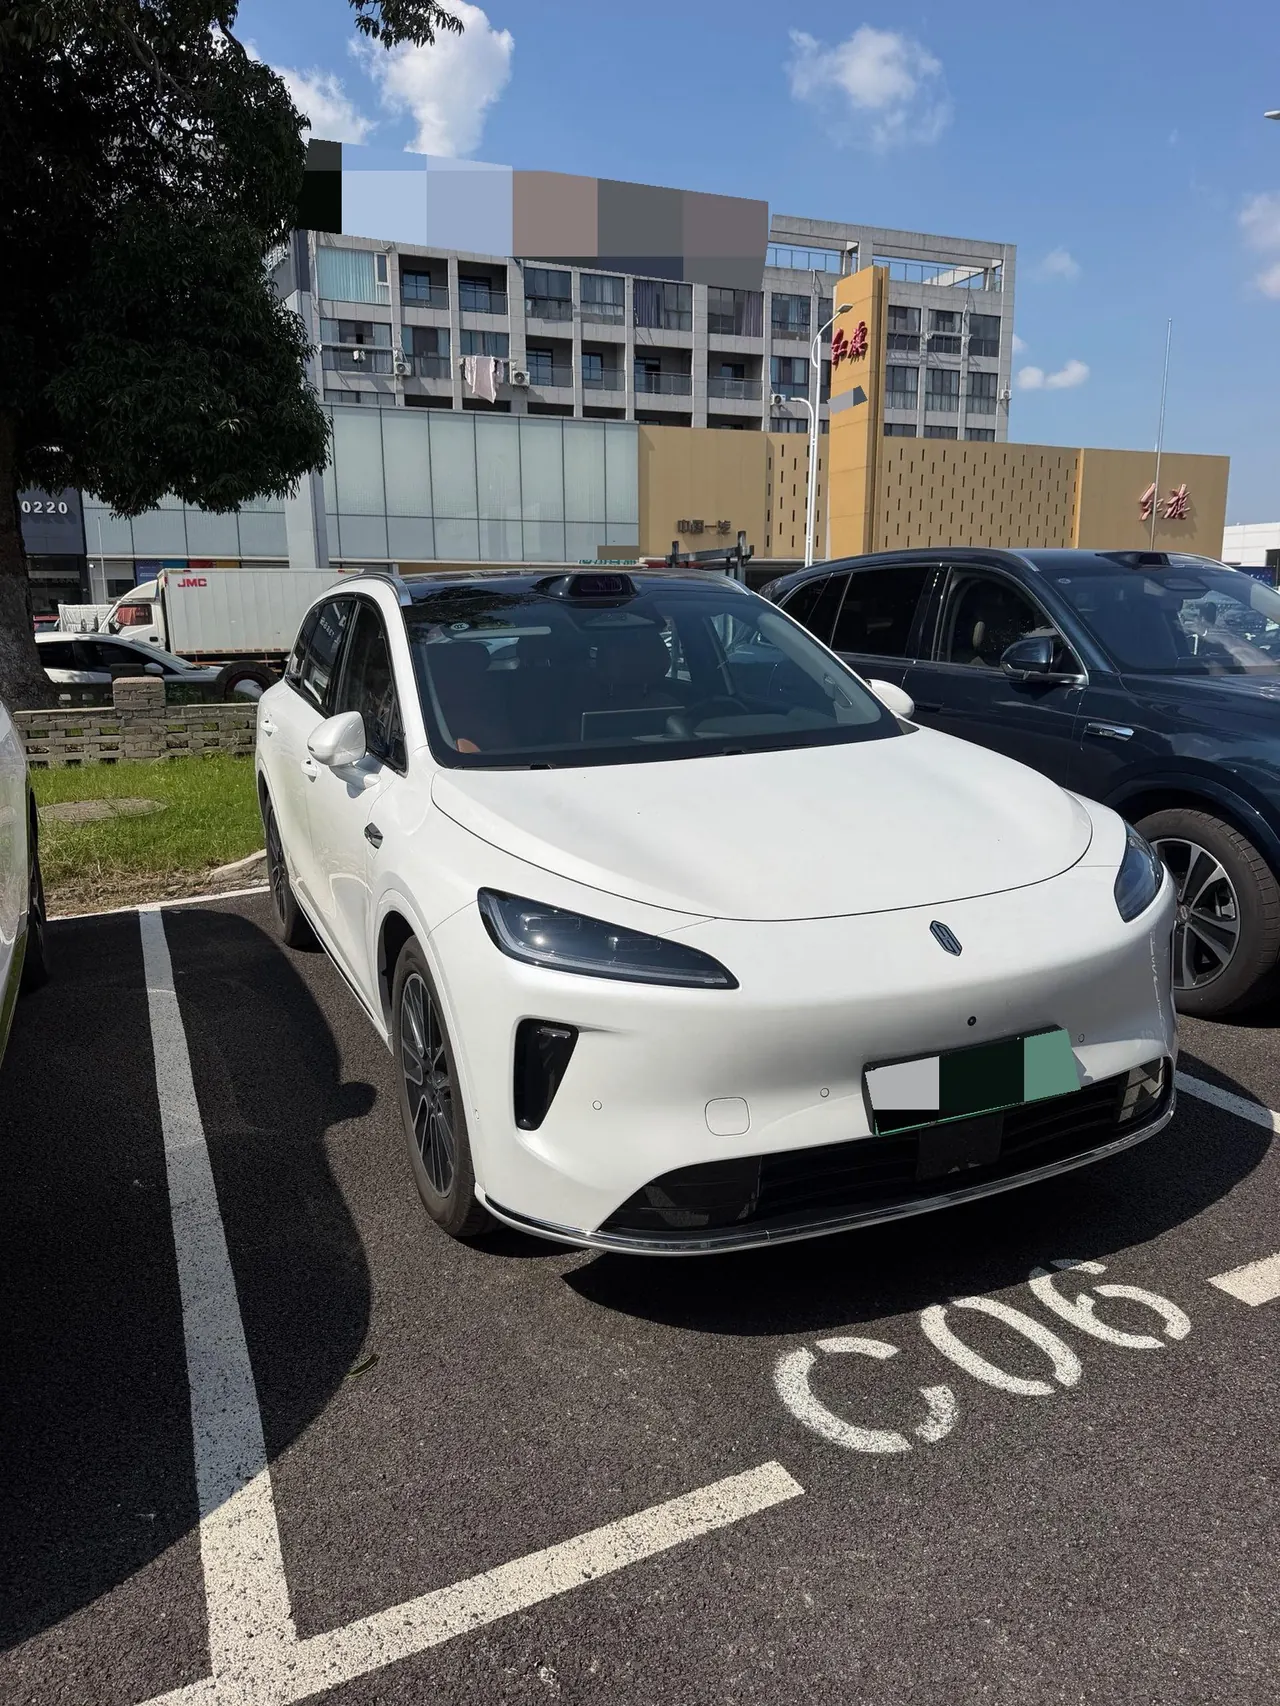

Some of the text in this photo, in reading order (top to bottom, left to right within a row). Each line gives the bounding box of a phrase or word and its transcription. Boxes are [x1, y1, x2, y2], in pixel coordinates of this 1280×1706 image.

[21, 501, 68, 515] 0220
[1139, 482, 1191, 521] 红旗
[177, 578, 208, 587] JMC
[774, 1257, 1192, 1454] C06
